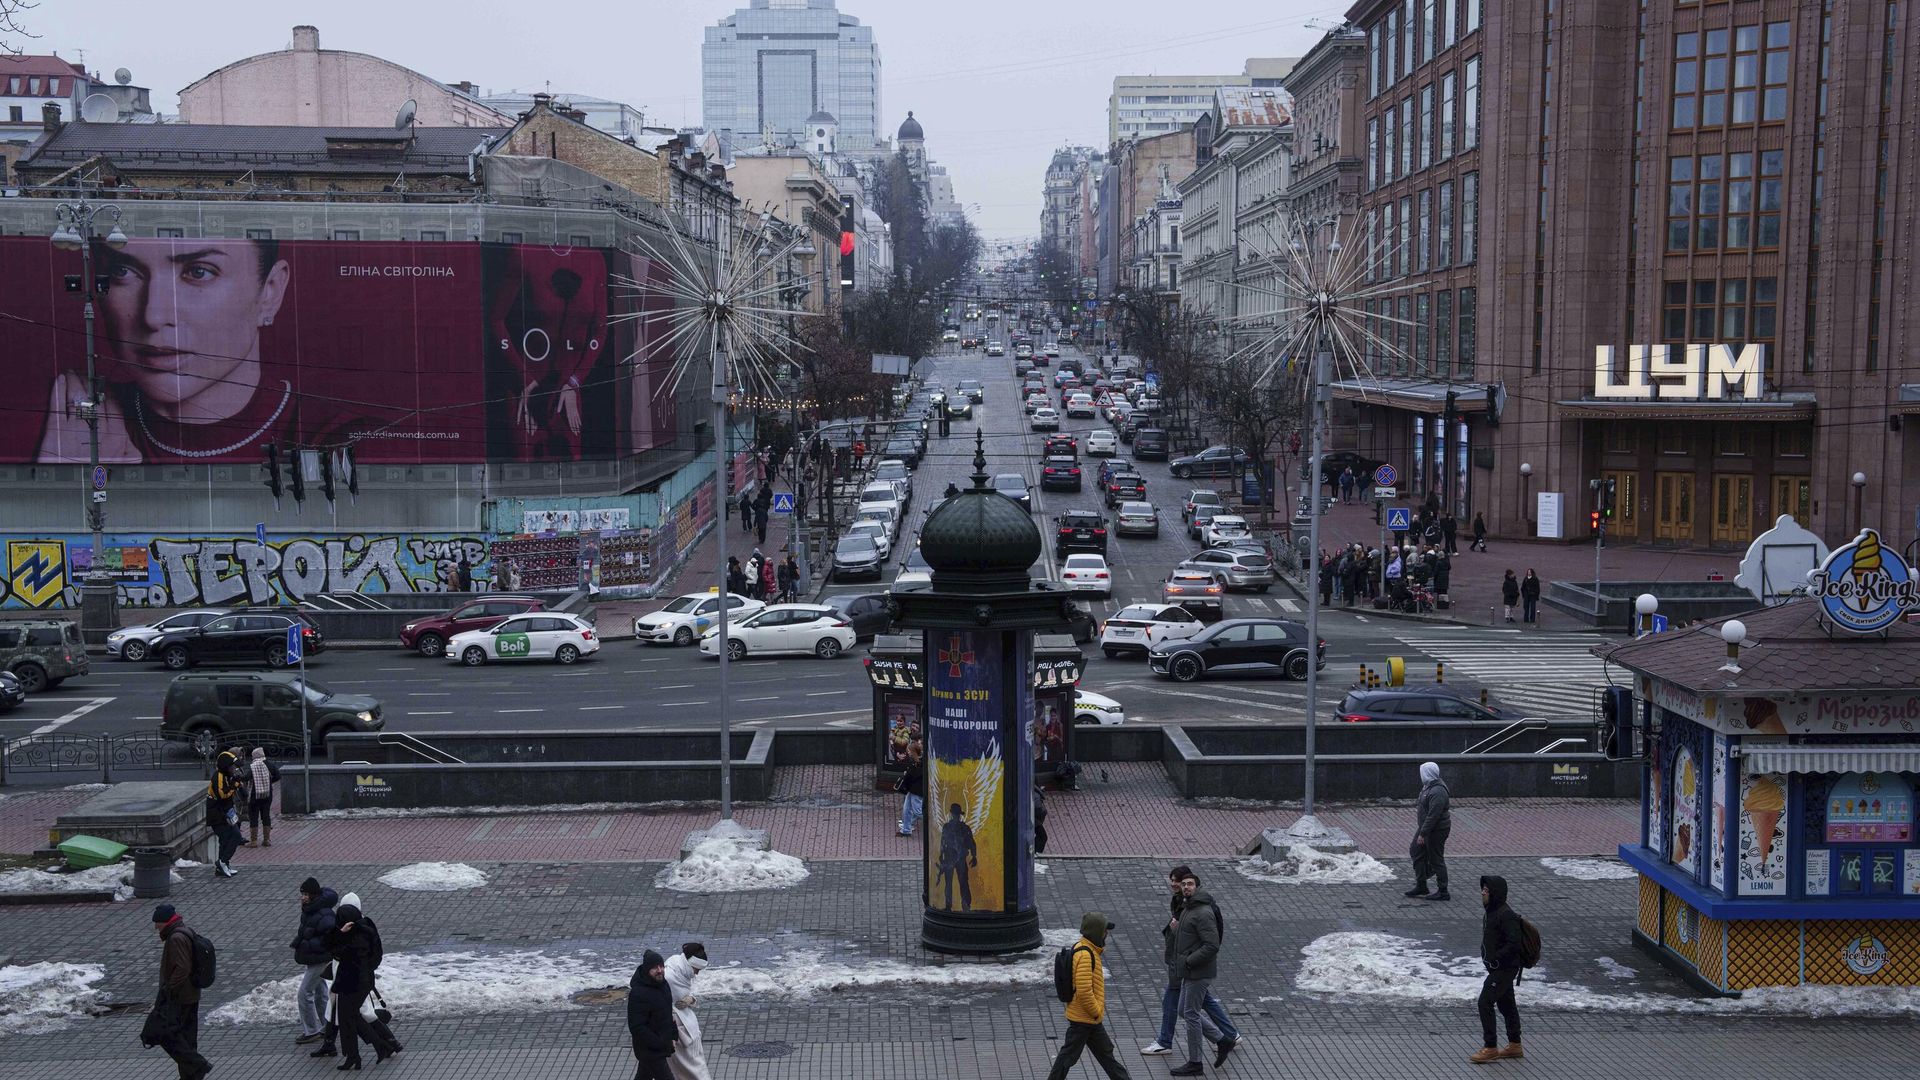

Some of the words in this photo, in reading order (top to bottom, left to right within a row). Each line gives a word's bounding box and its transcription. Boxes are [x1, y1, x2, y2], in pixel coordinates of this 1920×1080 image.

[340, 266, 380, 276] ЕЛІНА
[383, 266, 455, 277] СВІТОЛІНА
[501, 328, 599, 361] SOLO
[1595, 344, 1764, 399] ЦУМ
[1812, 572, 1853, 597] Ice
[1855, 571, 1919, 607] King
[500, 640, 525, 652] Bolt
[964, 690, 989, 701] ЗСУ!
[945, 707, 967, 718] НАШІ
[1750, 882, 1774, 890] LEMON
